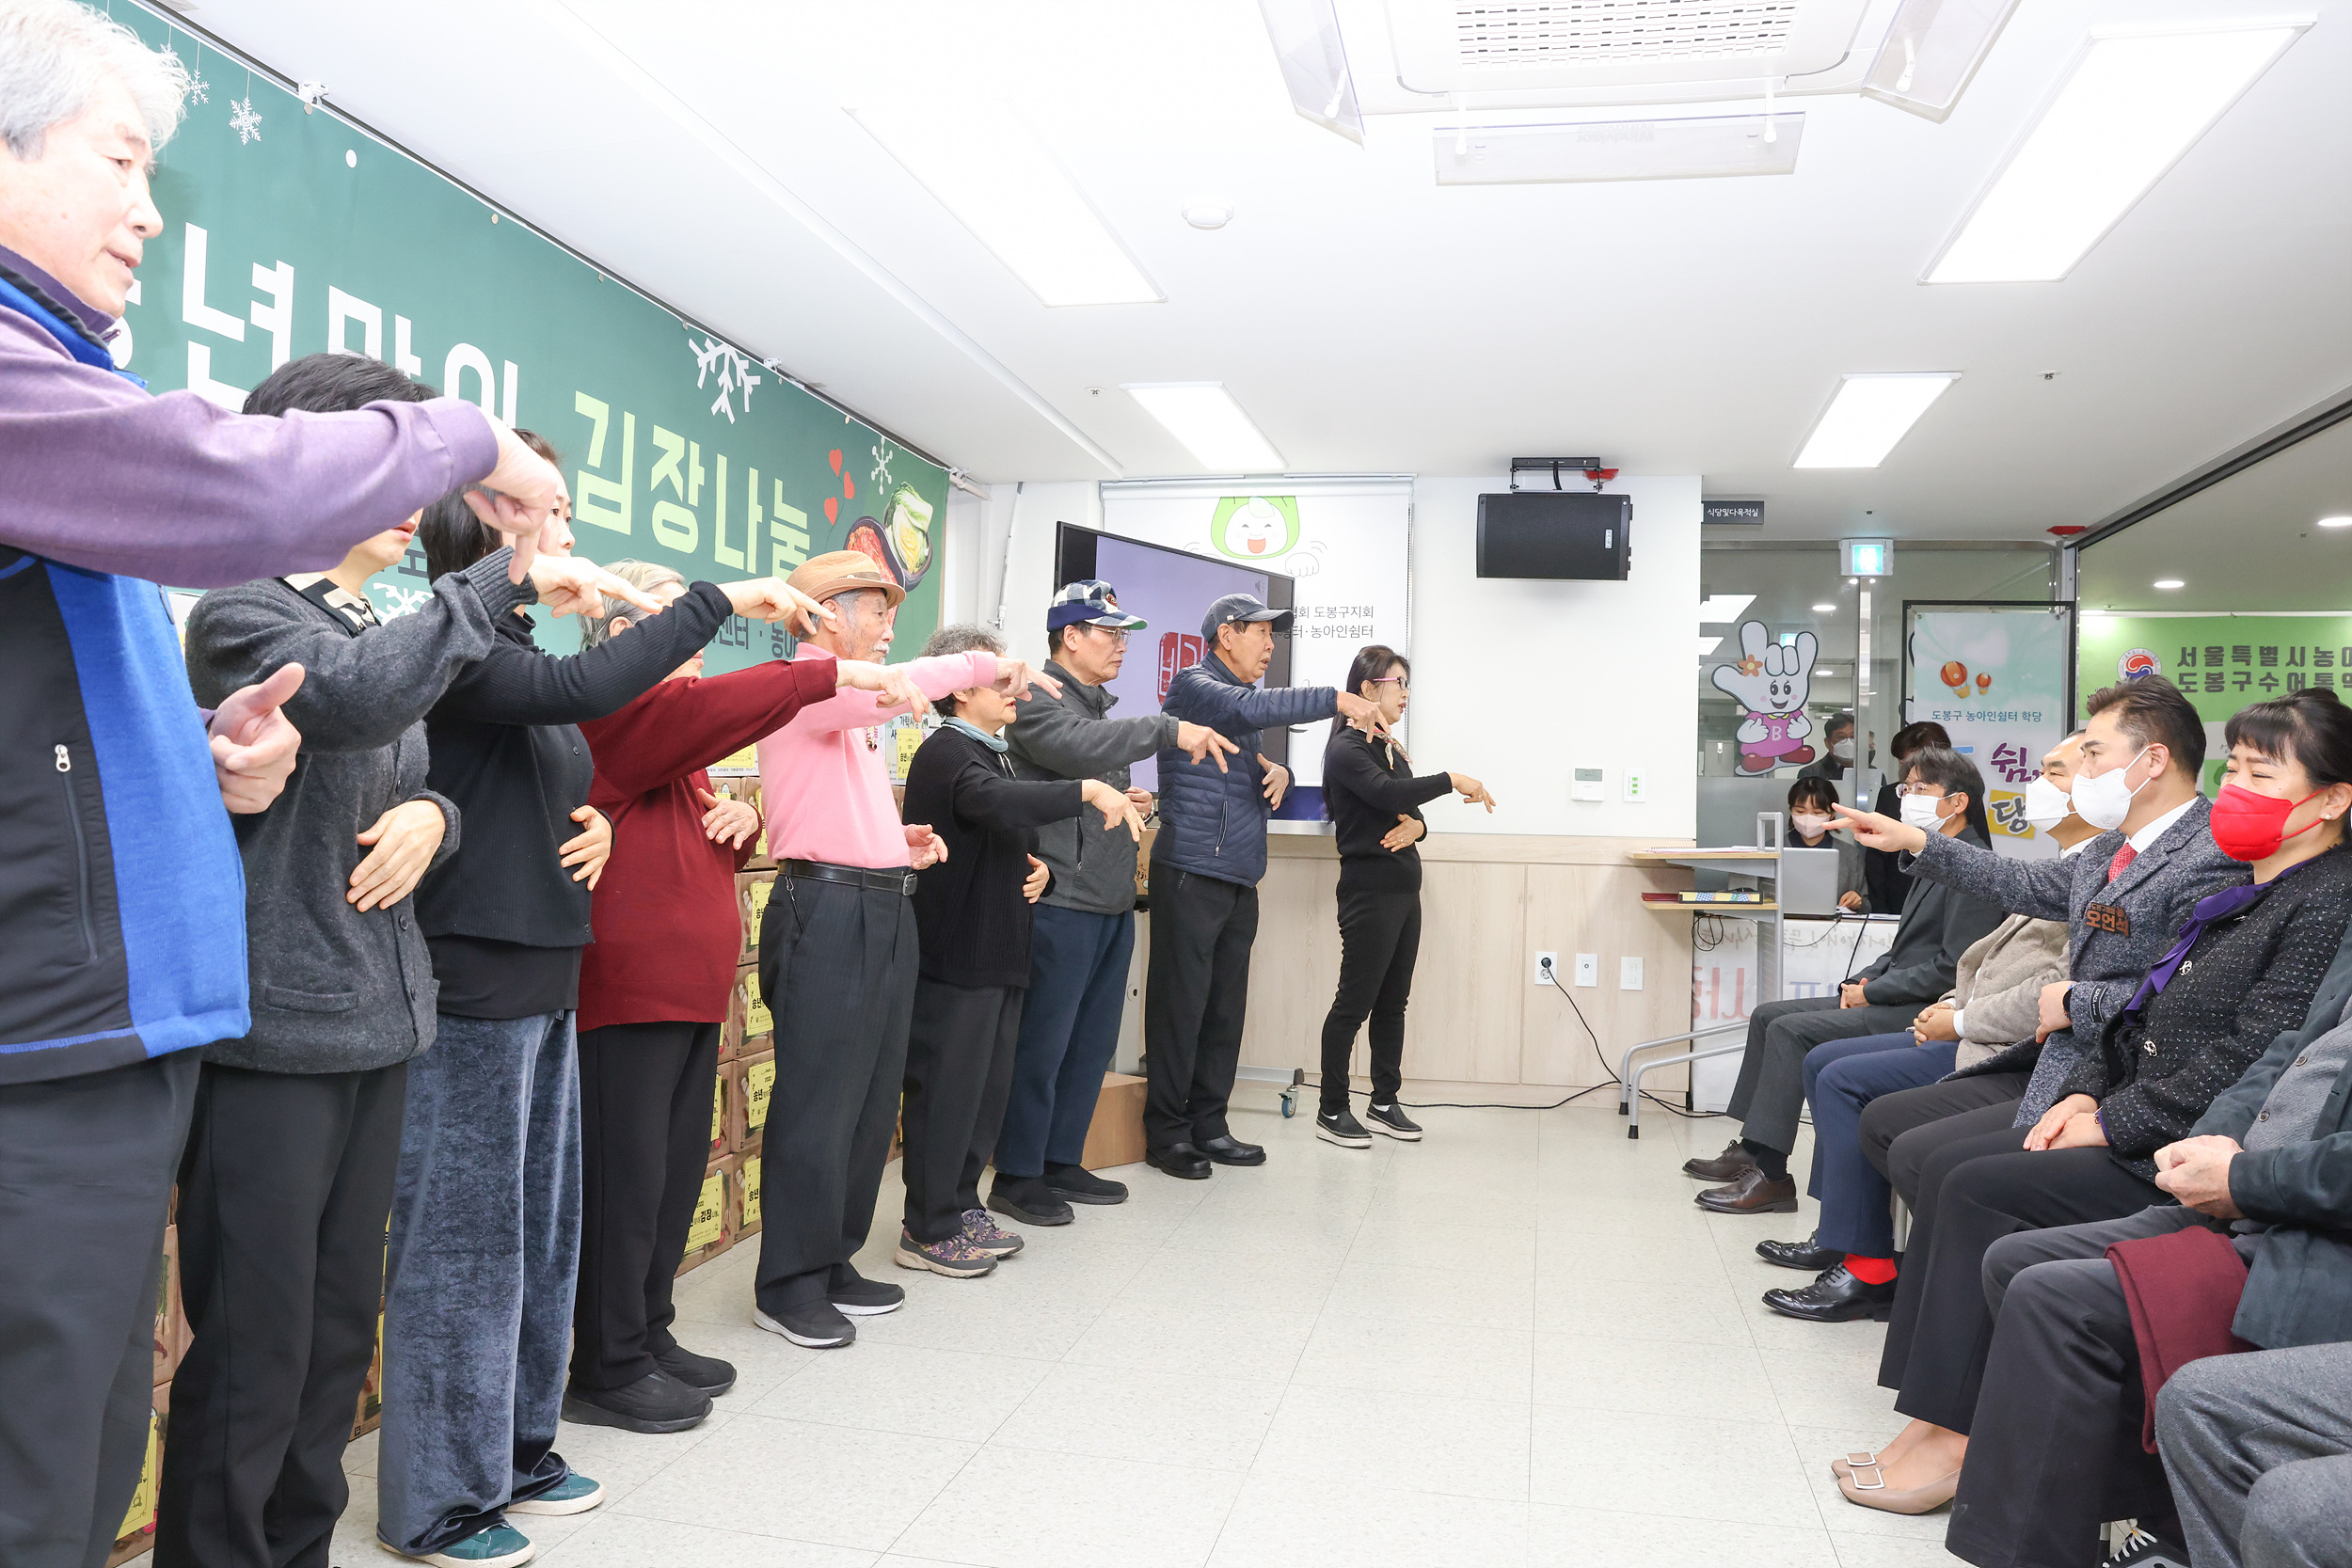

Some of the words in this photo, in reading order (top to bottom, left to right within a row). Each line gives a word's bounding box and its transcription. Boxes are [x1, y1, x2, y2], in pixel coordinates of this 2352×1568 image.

[575, 390, 811, 583] 김장나눔
[1708, 508, 1758, 517] 식당및다목적실
[1314, 606, 1374, 619] 도봉구지회
[1931, 711, 1963, 721] 도봉구
[1966, 711, 2018, 722] 농아인쉼터
[2022, 711, 2042, 722] 학당
[1772, 725, 1783, 741] B
[2086, 910, 2130, 939] 오언석
